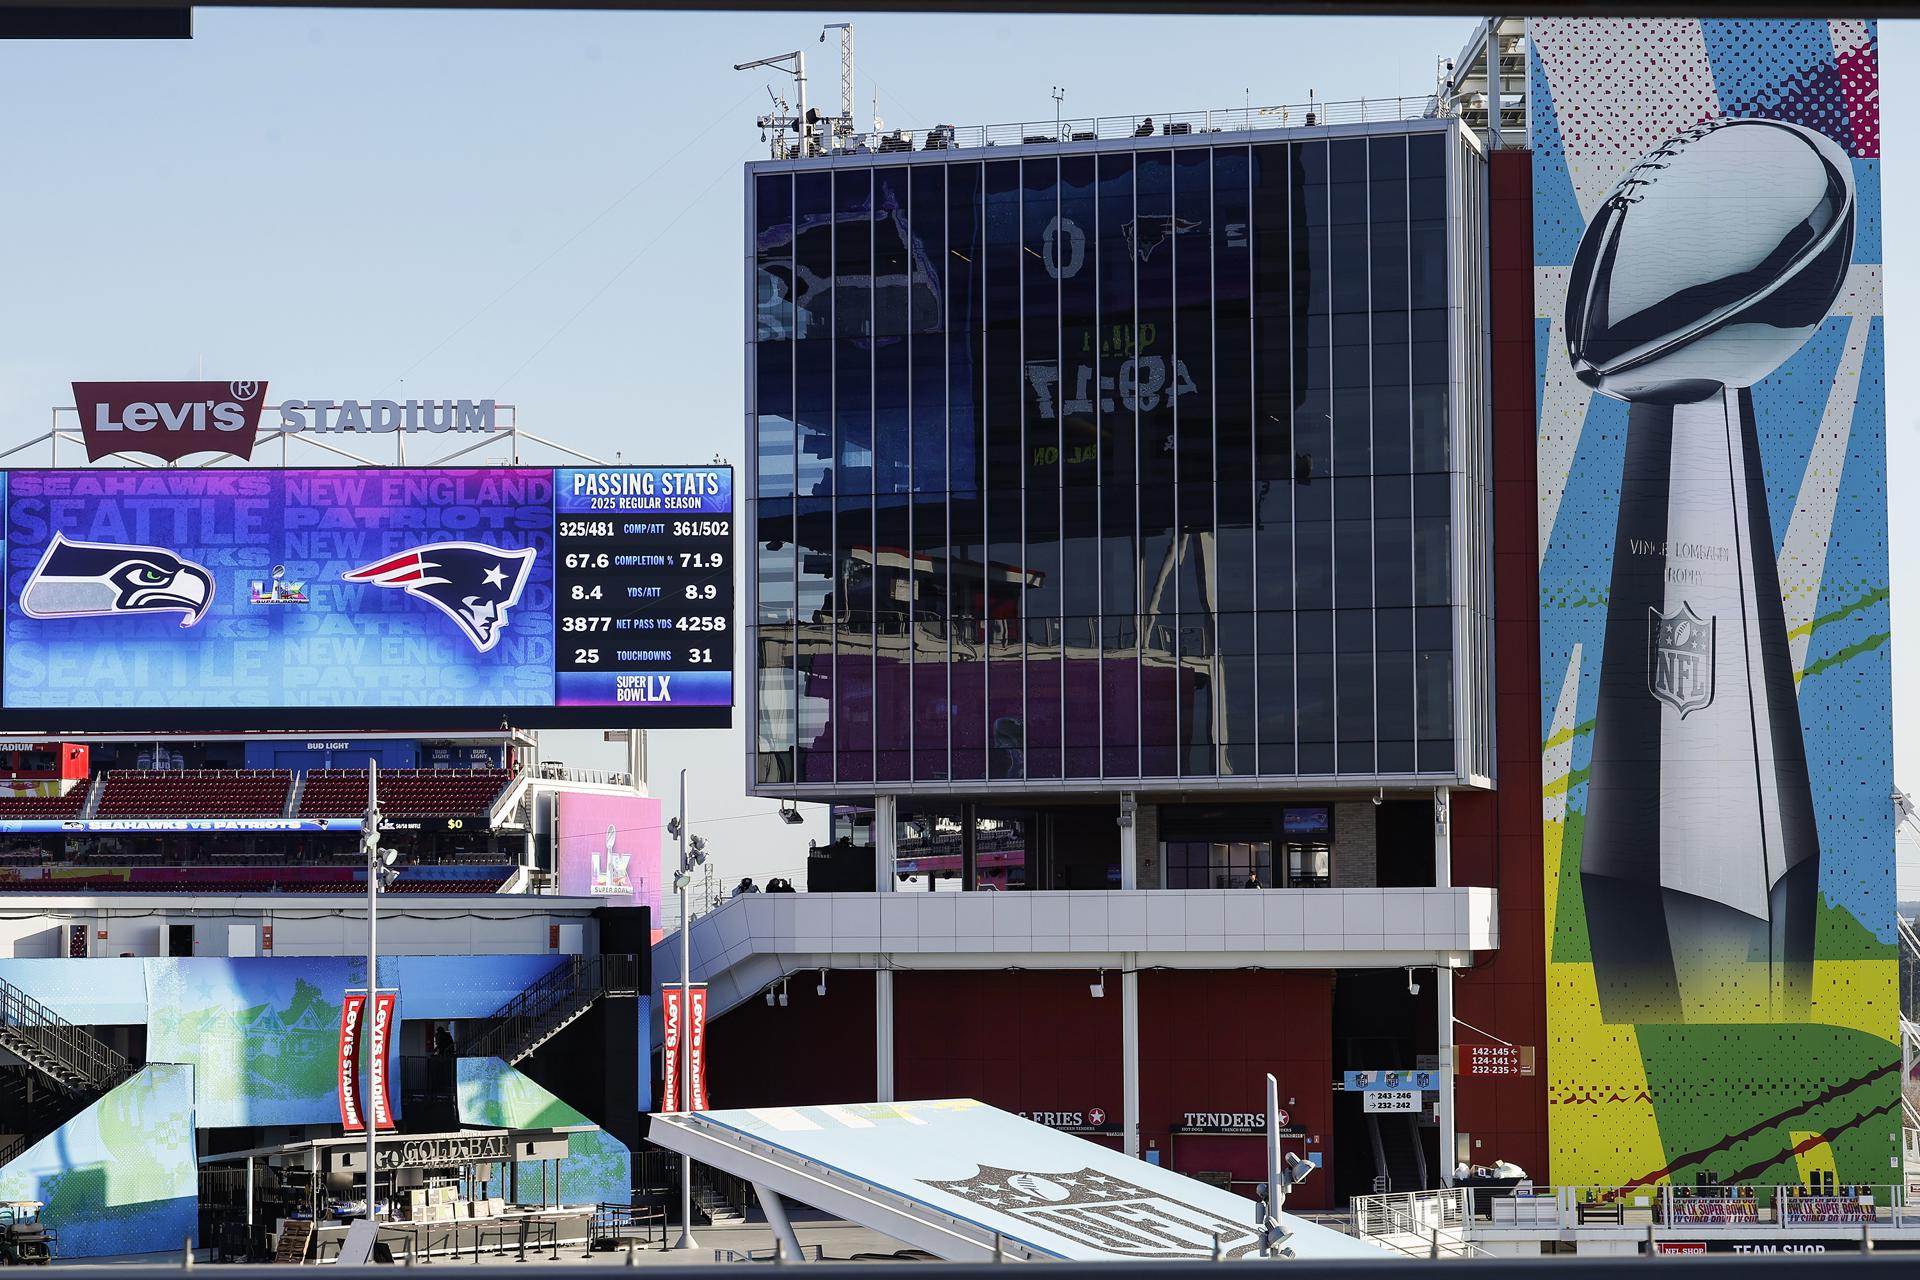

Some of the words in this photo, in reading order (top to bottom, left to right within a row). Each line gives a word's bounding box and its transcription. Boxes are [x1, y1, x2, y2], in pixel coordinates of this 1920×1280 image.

[280, 399, 496, 433] STADIUM
[10, 476, 272, 496] SEAHAWKS
[574, 473, 654, 495] PASSING
[662, 472, 719, 495] STATS
[285, 478, 366, 506] NEW
[381, 478, 551, 506] ENGLAND
[591, 498, 616, 509] 2025
[619, 498, 661, 509] REGULAR
[664, 497, 702, 509] SEASON
[9, 498, 270, 544] SEATTLE
[283, 506, 551, 529] PATRIOTS
[559, 522, 614, 536] 325/481
[624, 523, 665, 534] COMP/ATT
[673, 521, 729, 536] 361/502
[285, 531, 366, 559] NEW
[565, 553, 609, 568] 67.6
[614, 555, 664, 566] COMPLETION
[667, 556, 674, 566] %
[679, 553, 723, 568] 71.9
[571, 585, 603, 599] 8.4
[627, 587, 661, 597] YDS/ATT
[685, 584, 717, 599] 8.9
[562, 617, 612, 632] 3877
[616, 619, 631, 629] NET
[633, 619, 654, 629] PASS
[657, 619, 672, 629] YDS
[675, 616, 726, 631] 4258
[284, 638, 366, 664] NEW
[574, 648, 600, 663] 25
[617, 650, 672, 661] TOUCHDOWNS
[688, 648, 712, 663] 31
[8, 641, 270, 688] SEATTLE
[282, 665, 551, 688] PATRIOTS
[1656, 651, 1705, 700] NFL
[616, 675, 646, 688] SUPER
[647, 675, 671, 702] LX
[617, 688, 646, 702] BOWL
[0, 743, 33, 752] TADIUM
[307, 742, 324, 750] BUD
[88, 820, 188, 830] SEAHAWKS
[214, 820, 302, 829] PATRIOTS
[447, 818, 463, 829] $0
[1472, 1048, 1509, 1056] 142-145
[1472, 1057, 1509, 1065] 124-141
[1472, 1066, 1509, 1074] 232-235
[666, 1050, 674, 1111] STADIUM
[692, 1049, 703, 1111] STADIUM
[343, 1059, 358, 1125] STADIUM
[375, 1059, 387, 1123] STADIUM
[1032, 1111, 1083, 1126] FRIES
[1184, 1112, 1265, 1127] TENDERS
[403, 1139, 462, 1160] GOLD
[468, 1136, 511, 1157] BAR
[1699, 1203, 1726, 1215] SUPER
[1726, 1204, 1747, 1215] BOWL
[1733, 1245, 1777, 1254] TEAM
[1783, 1245, 1826, 1254] SHOP
